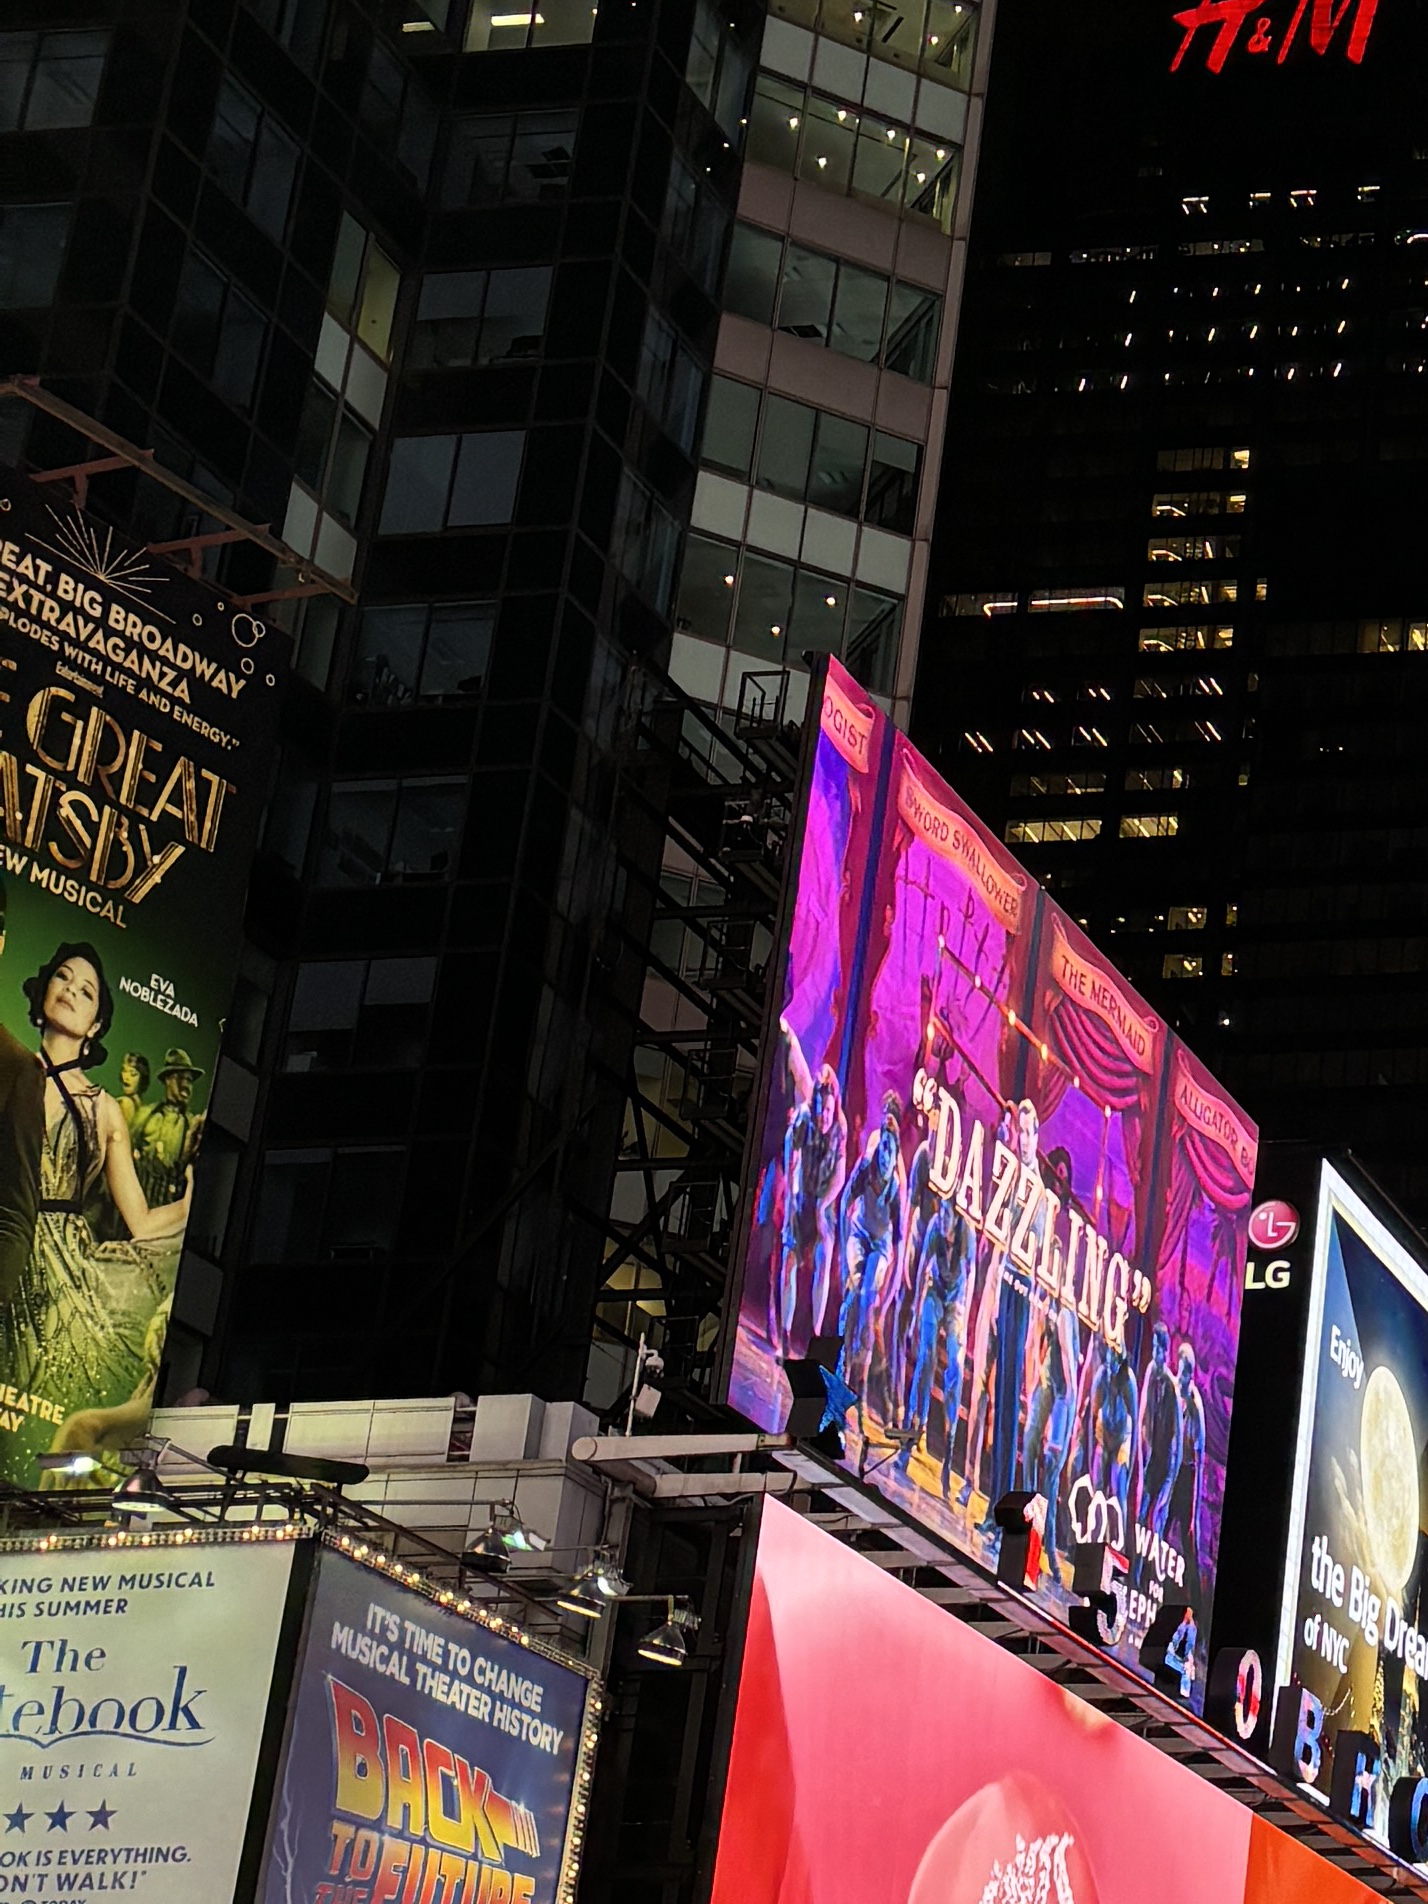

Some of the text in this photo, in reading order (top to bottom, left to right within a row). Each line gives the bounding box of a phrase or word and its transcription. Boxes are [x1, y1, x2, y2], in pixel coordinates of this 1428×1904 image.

[58, 571, 247, 701] BIG BROADWAY
[64, 642, 171, 716] WITH LIFE AND
[26, 686, 237, 853] GREAT
[30, 864, 129, 929] MUSICAL
[952, 830, 1020, 919] SWALLOWER
[119, 975, 199, 1029] NOBLEZADA
[149, 972, 177, 999] EVA
[1060, 954, 1147, 1057] THE MERMAID
[1181, 1084, 1239, 1153] ALLIGATOR
[1244, 1258, 1291, 1291] LG
[1328, 1323, 1367, 1392] Enjoy
[59, 1570, 216, 1594] NEW MUSICAL
[1134, 1523, 1186, 1588] WATER
[33, 1598, 129, 1617] SUMMER
[1310, 1534, 1347, 1609] the
[1347, 1562, 1381, 1650] Big
[21, 1639, 107, 1674] The
[403, 1619, 544, 1713] TIME TO CHANGE
[1303, 1612, 1349, 1675] of NYC
[331, 1621, 564, 1755] MUSICAL THEATER HISTORY
[19, 1762, 138, 1781] MUSICAL
[328, 1674, 542, 1864] BACK
[36, 1845, 192, 1867] IS EVERYTHING.
[329, 1819, 376, 1883] TO
